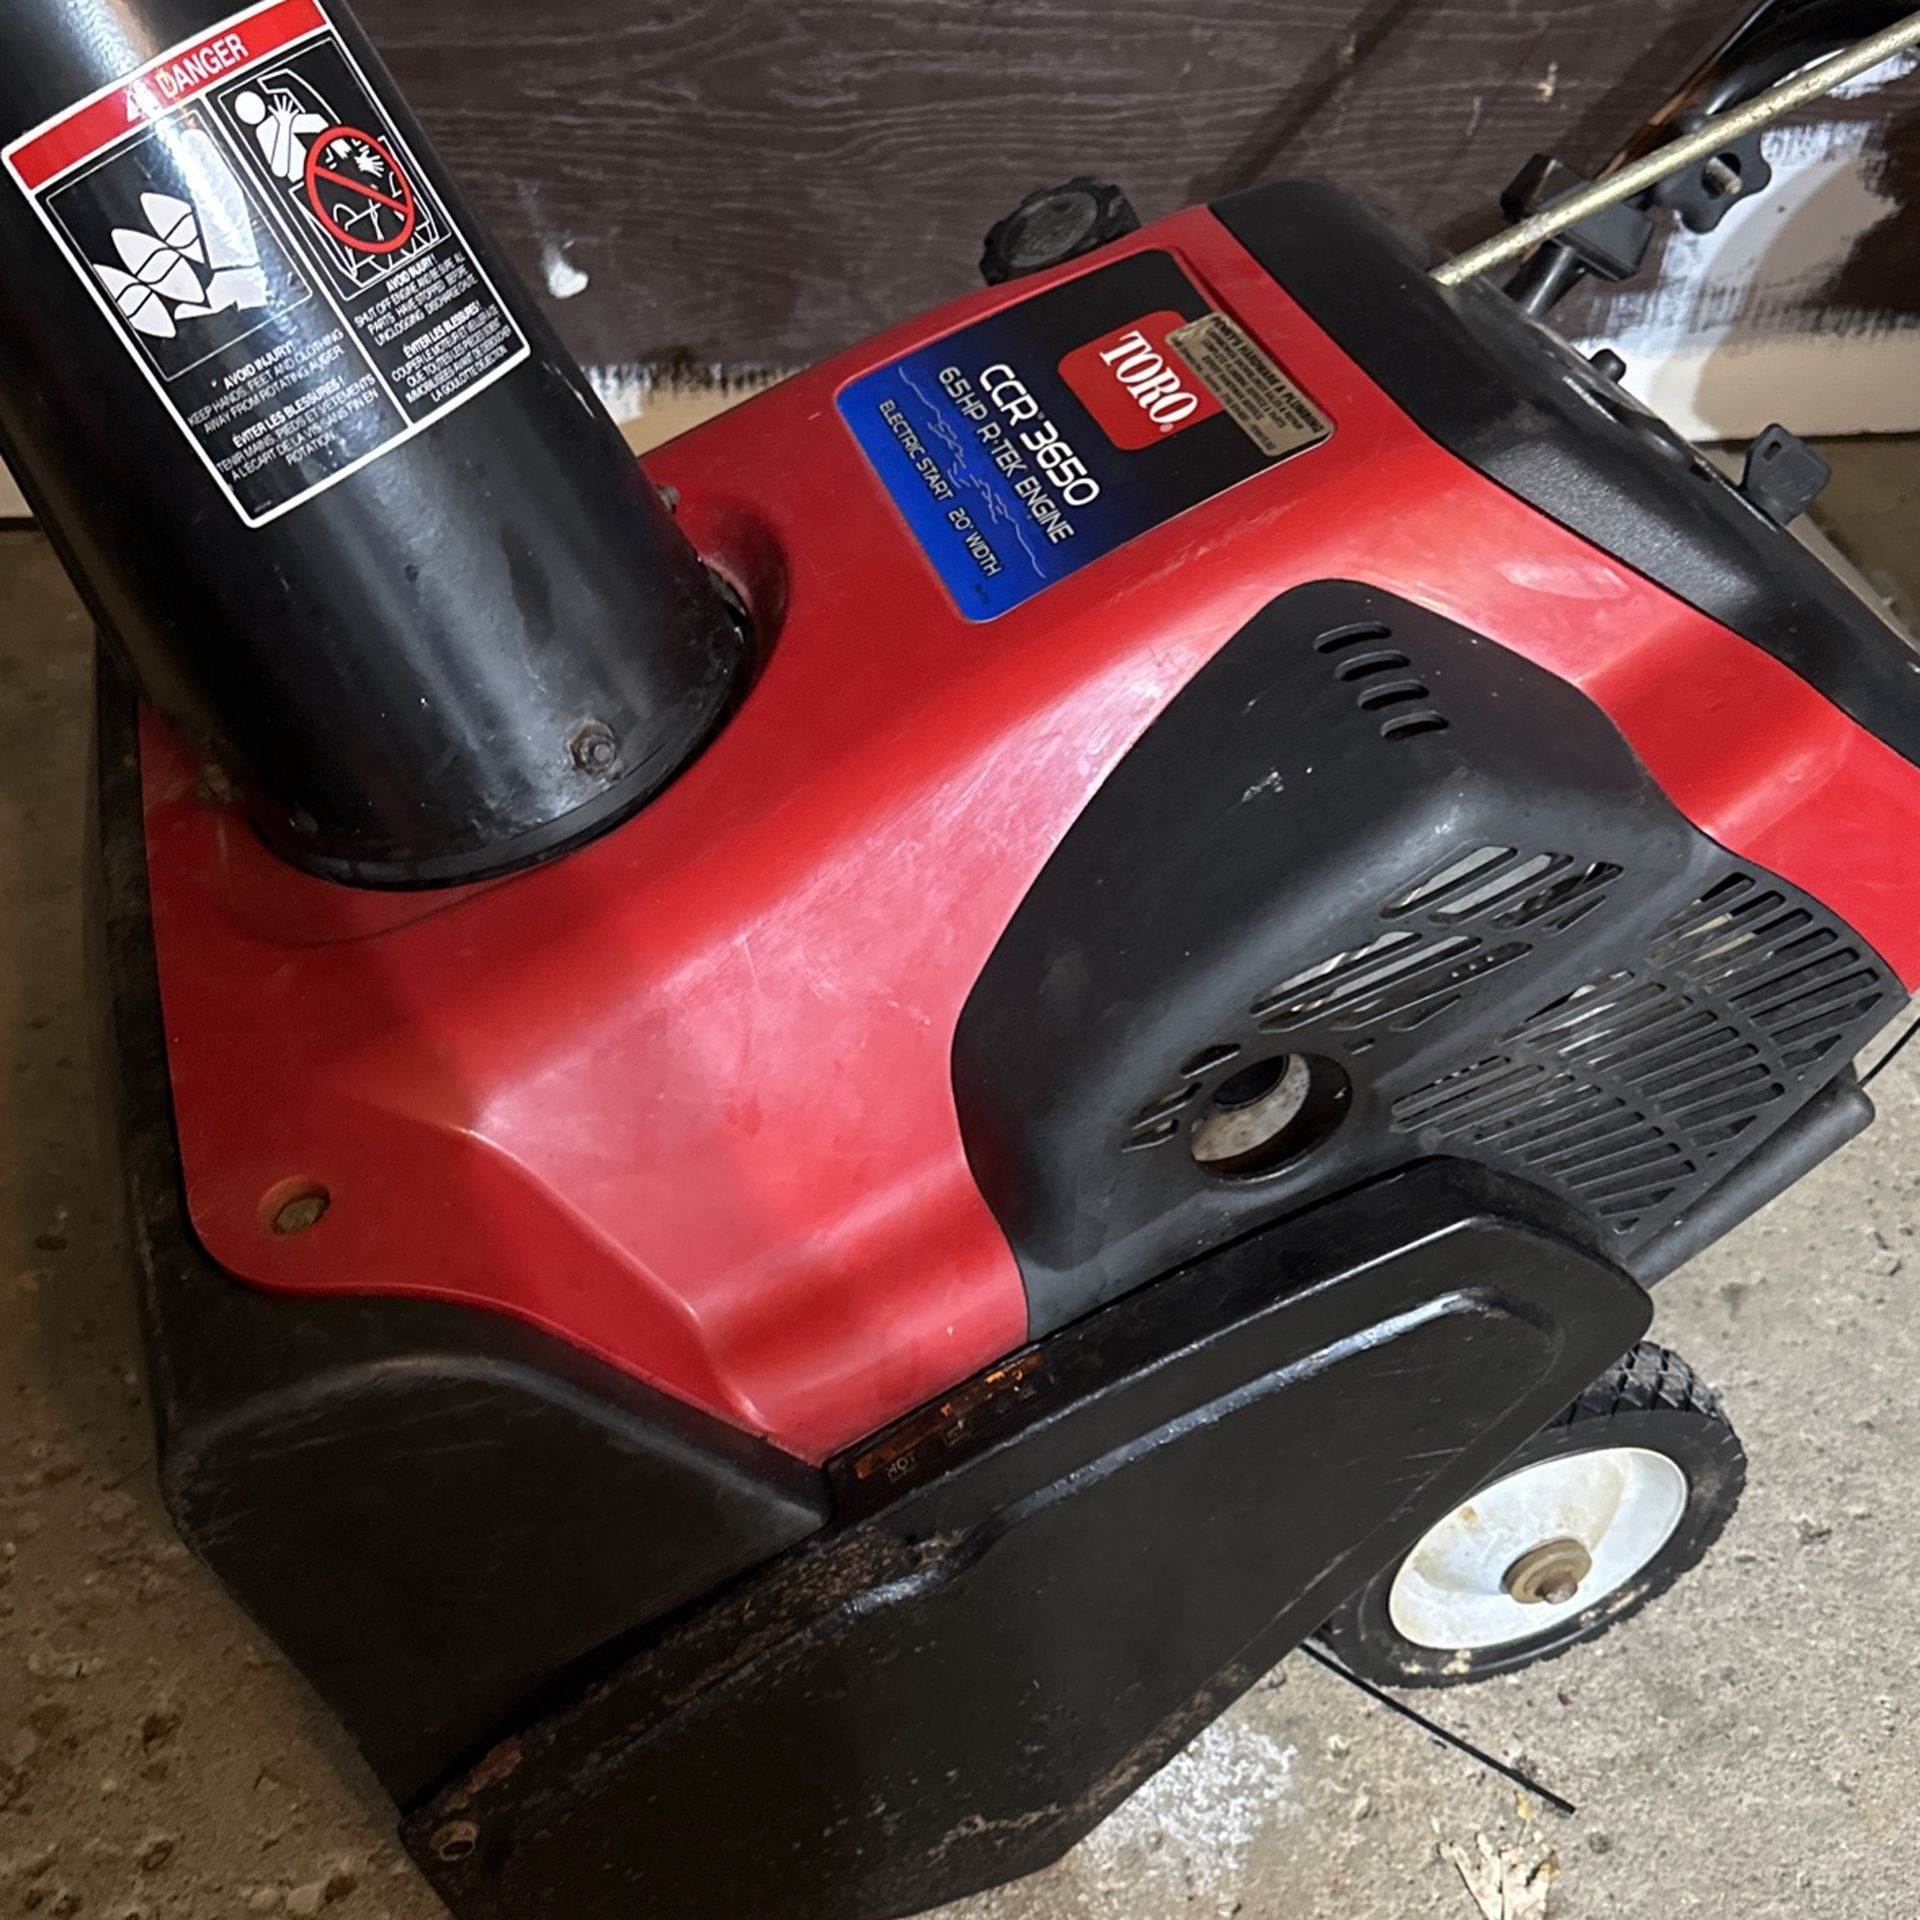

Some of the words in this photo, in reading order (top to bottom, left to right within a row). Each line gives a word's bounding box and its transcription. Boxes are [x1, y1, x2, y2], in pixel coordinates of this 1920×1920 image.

[153, 31, 250, 100] DANGER
[373, 296, 394, 315] OFF
[185, 404, 214, 427] KEEP
[245, 368, 275, 392] FEET
[271, 356, 296, 377] AND
[292, 327, 345, 364] CLOTHING
[201, 409, 234, 434] AWAY
[229, 393, 262, 418] FROM
[257, 364, 310, 402] ROTATING
[220, 362, 257, 390] AVOID
[263, 410, 285, 430] LES
[273, 414, 307, 439] PIEDS
[302, 406, 320, 422] ET
[274, 438, 293, 455] DE
[289, 430, 307, 447] LA
[302, 420, 323, 439] VIS
[319, 405, 349, 429] SANS
[361, 387, 380, 404] EN
[875, 398, 926, 460] ELECTRIC
[913, 455, 954, 503] START
[962, 530, 1003, 577] WIDTH
[1016, 419, 1105, 511] 3650
[1012, 474, 1076, 545] ENGINE
